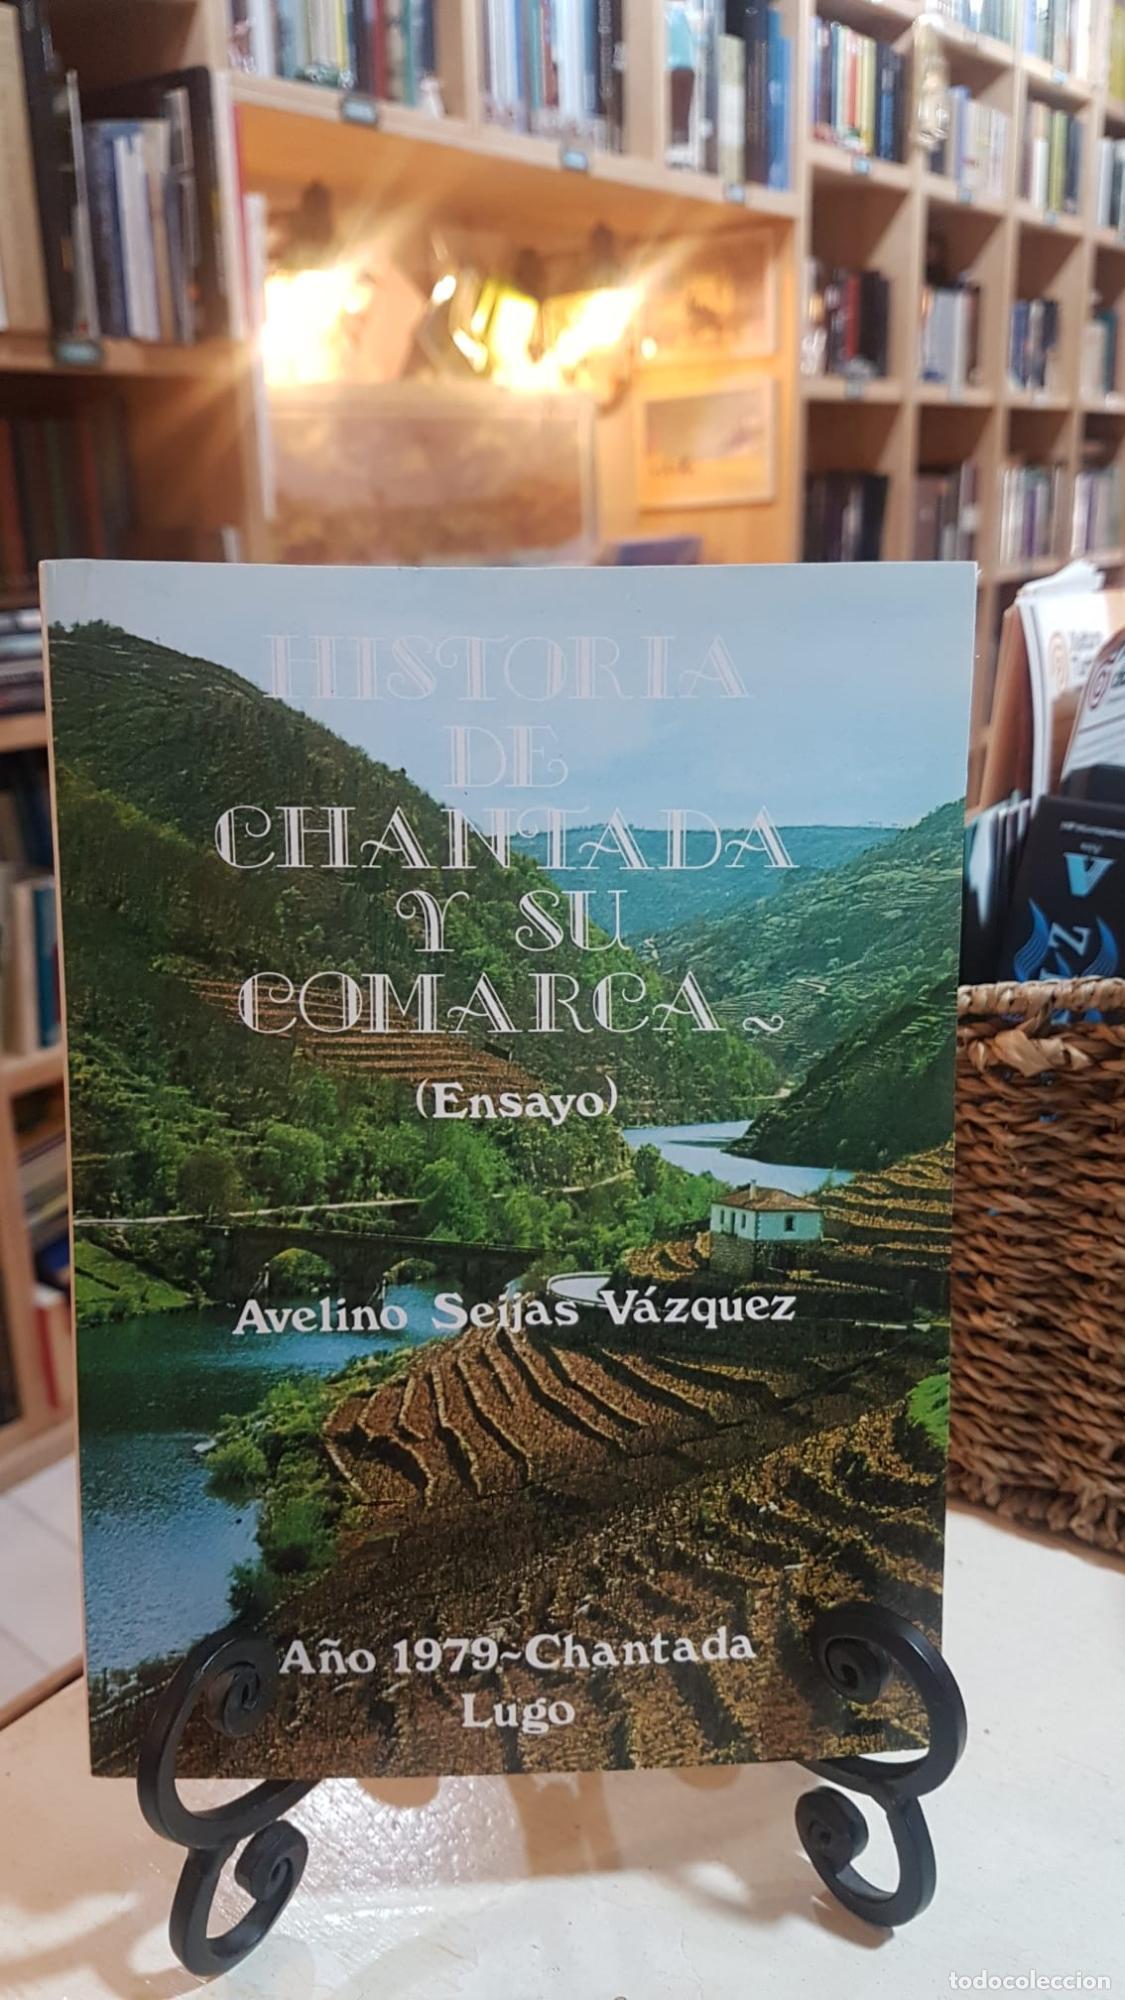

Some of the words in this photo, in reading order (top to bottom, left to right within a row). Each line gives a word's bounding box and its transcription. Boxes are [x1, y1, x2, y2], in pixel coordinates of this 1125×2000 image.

[263, 634, 753, 700] HISTORIA
[443, 725, 568, 787] DE
[214, 805, 800, 870] CHANTADA
[396, 890, 470, 952] Y
[515, 889, 631, 951] SU
[238, 971, 727, 1033] COMARCA
[416, 1075, 618, 1126] (Ensayo)
[231, 1297, 408, 1335] Avelino
[431, 1292, 580, 1334] Seijas
[599, 1286, 797, 1329] Vázquez
[278, 1638, 377, 1675] Año
[461, 1692, 576, 1735] Lugo
